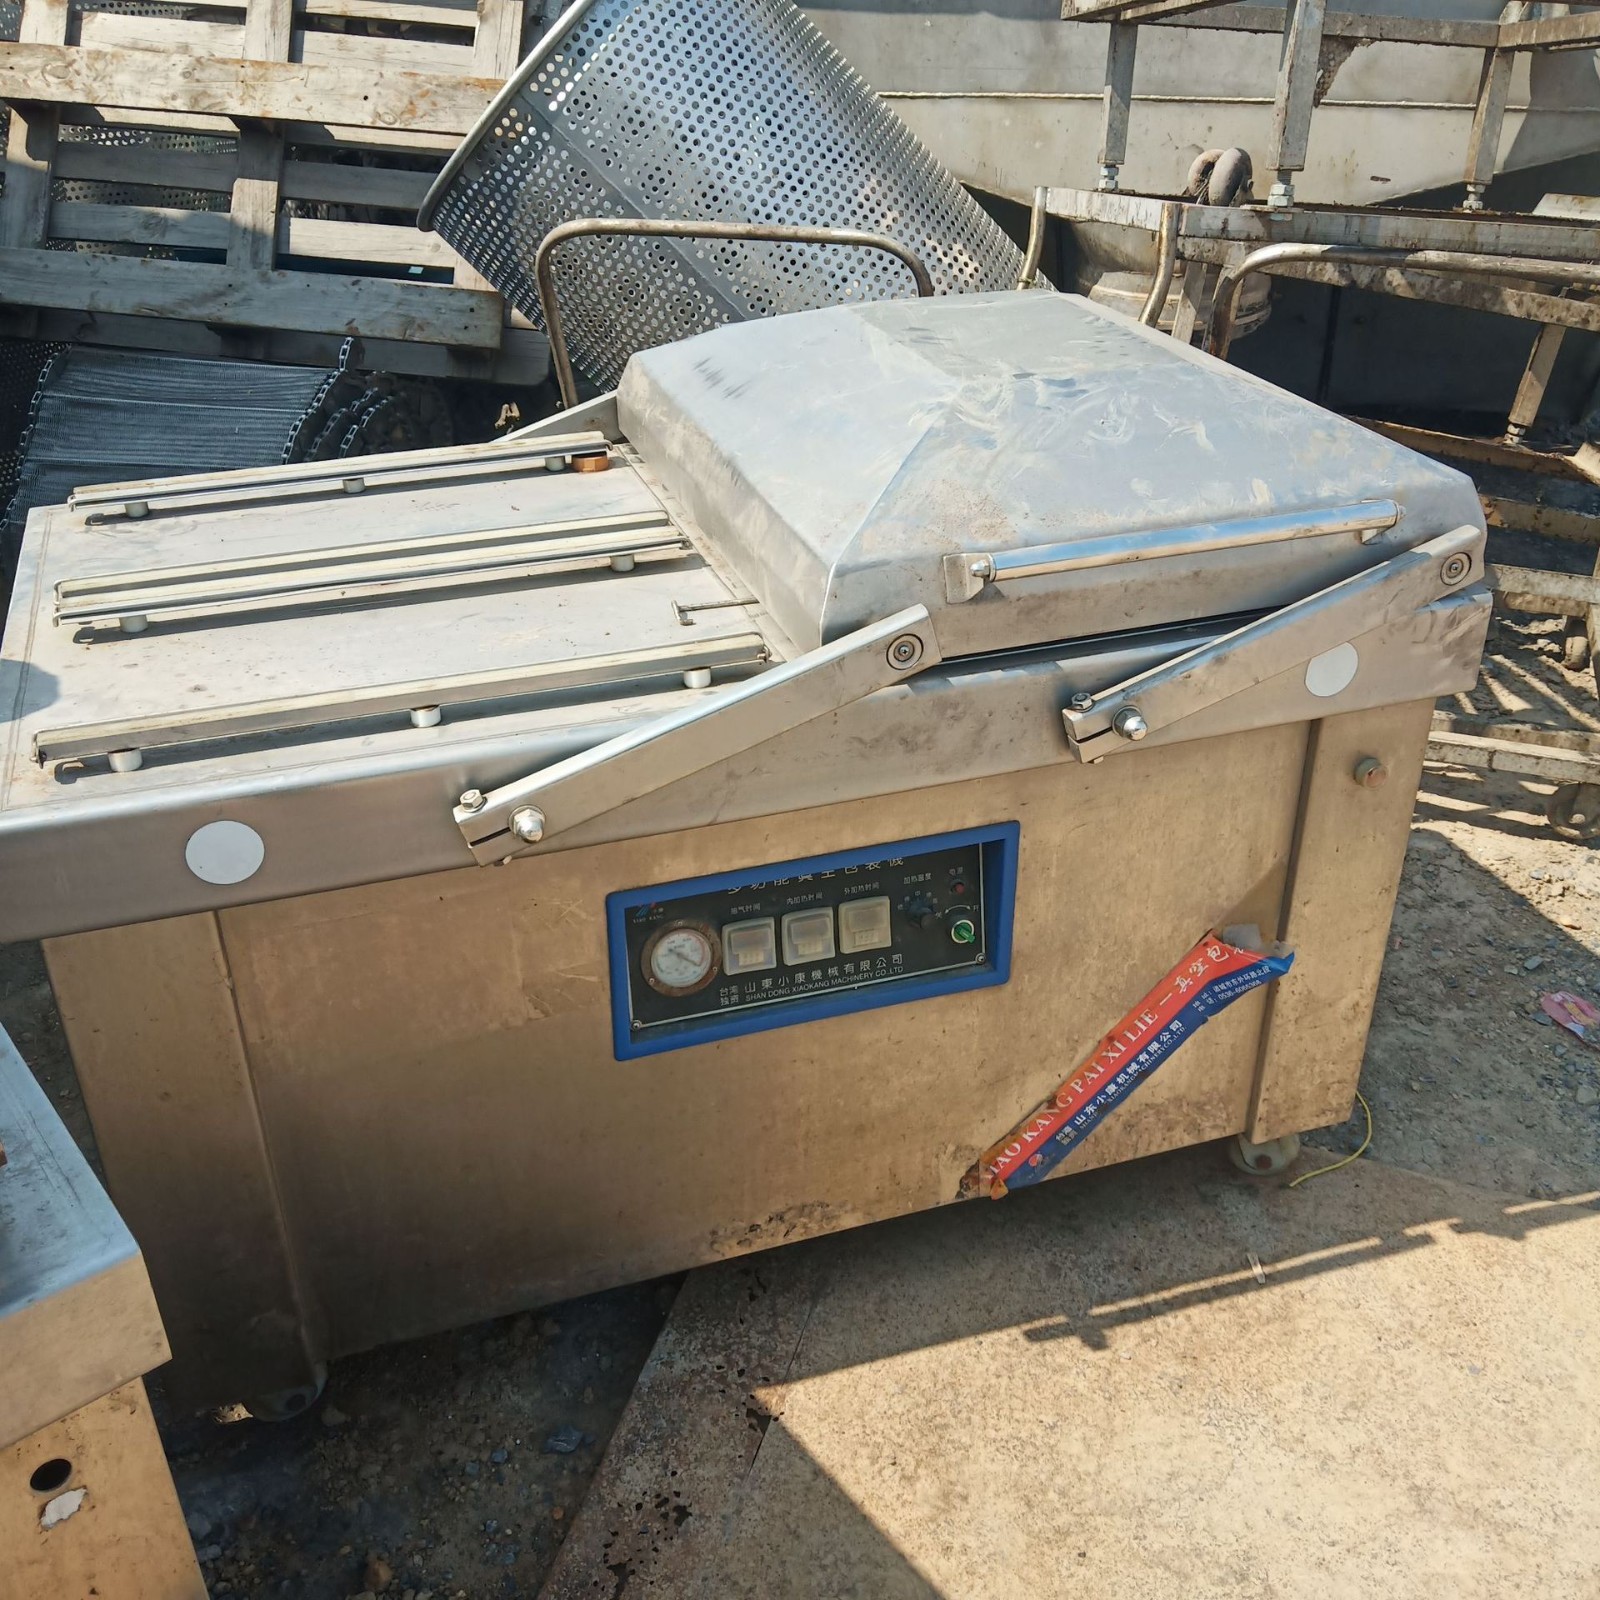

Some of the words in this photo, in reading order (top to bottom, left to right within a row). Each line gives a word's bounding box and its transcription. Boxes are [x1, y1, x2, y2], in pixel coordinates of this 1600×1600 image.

[745, 953, 903, 993] 山東小康機械有限公司
[745, 991, 766, 1002] SHAN
[768, 987, 790, 998] DONG
[792, 979, 830, 994] XIAOKANG
[831, 972, 873, 987] MACHINERY
[1022, 1092, 1073, 1143] KANG
[1070, 1062, 1105, 1094] PAI
[1101, 1040, 1127, 1064] XI
[1123, 1009, 1159, 1042] LIE
[1074, 1020, 1182, 1125] 山东小康机械有限公司
